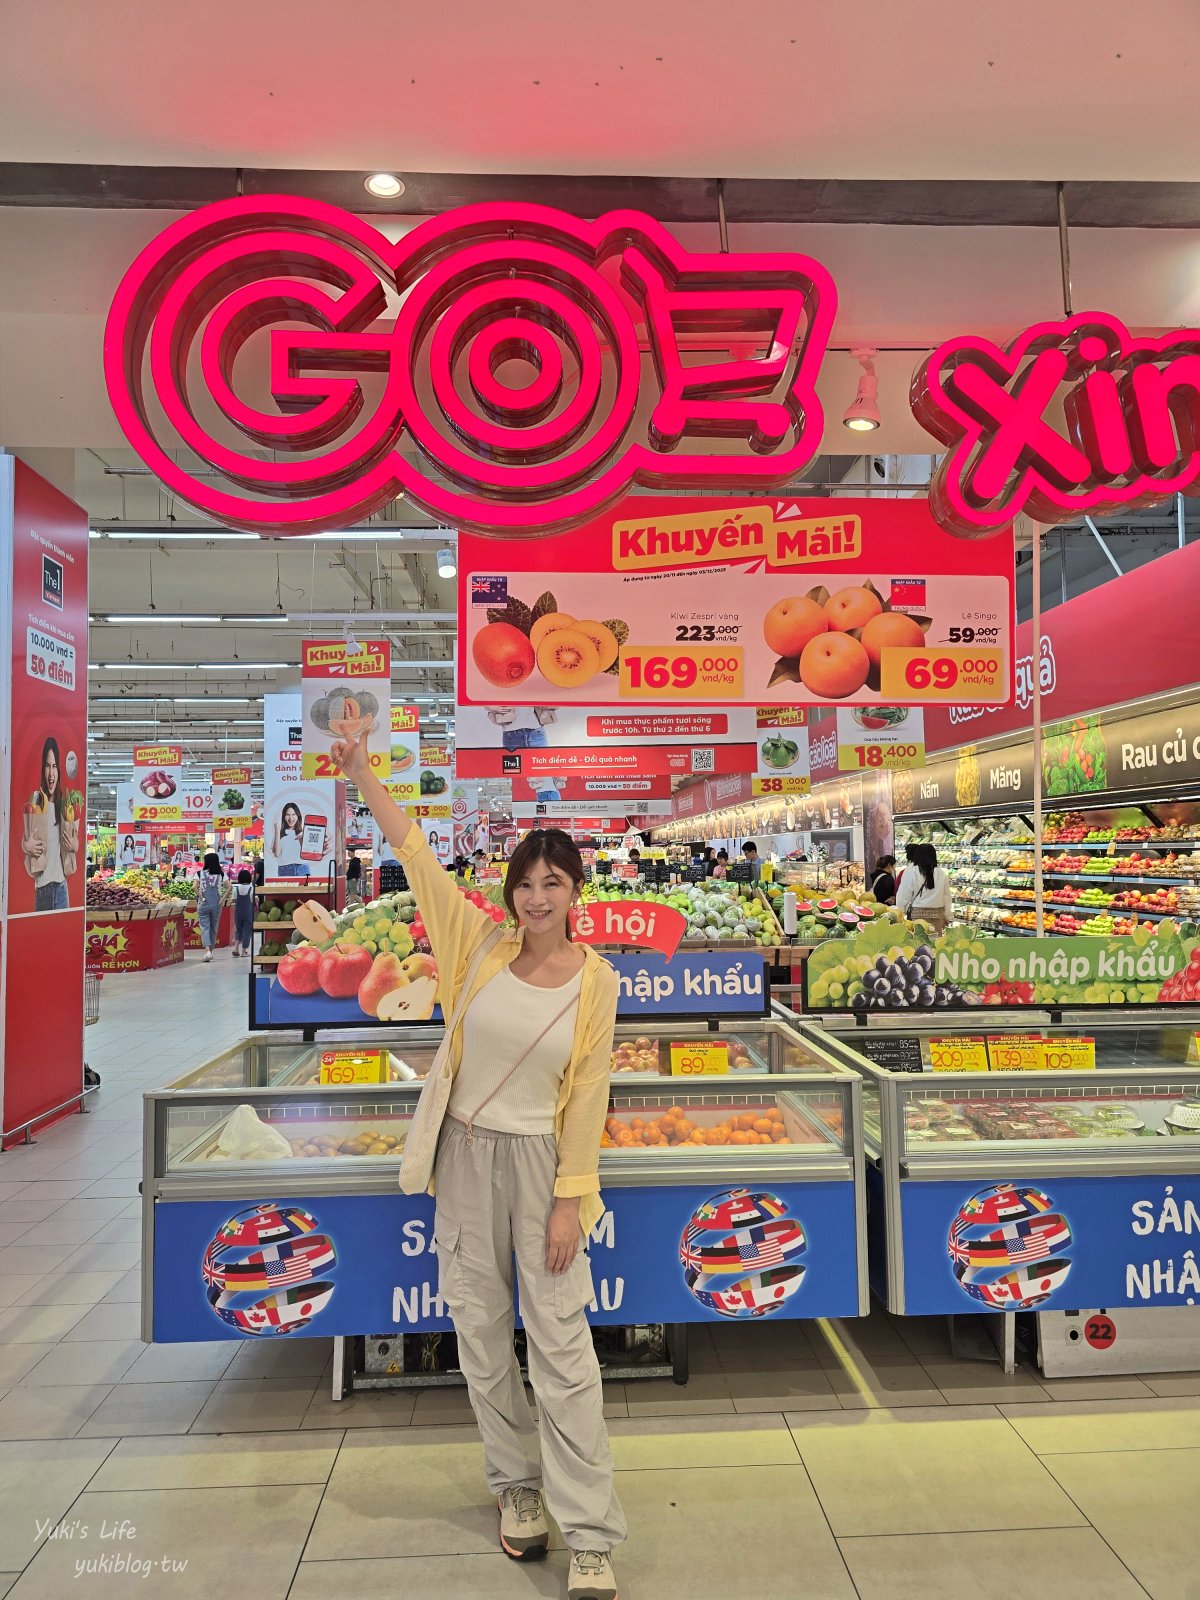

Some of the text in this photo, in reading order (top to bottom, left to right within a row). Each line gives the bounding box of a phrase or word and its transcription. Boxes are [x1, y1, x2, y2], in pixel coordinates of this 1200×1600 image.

[619, 513, 856, 560] Khuyến Mãi!
[670, 612, 739, 622] Kiwi Zespri vàng
[974, 612, 998, 621] Singo
[31, 632, 55, 652] 10.000
[56, 646, 68, 658] vnd
[715, 635, 738, 643] vnd/kg
[974, 636, 997, 644] vnd/kg
[31, 654, 73, 686] 50 điểm
[350, 655, 382, 673] Mãi!
[701, 673, 735, 684] vnd/kg
[962, 673, 995, 685] vnd/kg
[602, 726, 623, 734] trước
[674, 725, 689, 733] đến
[634, 718, 650, 726] thực
[652, 716, 674, 726] phẩm
[675, 716, 691, 724] tươi
[693, 716, 712, 725] sống
[1121, 743, 1158, 771] Rau
[1162, 727, 1187, 764] củ
[531, 756, 547, 764] Tích
[548, 755, 567, 764] điểm
[584, 754, 597, 763] Đổi
[598, 756, 613, 764] quà
[614, 755, 637, 763] nhanh
[990, 765, 1021, 791] Măng
[920, 777, 940, 800] Nấm
[605, 907, 656, 941] hội
[101, 958, 117, 969] RẺ
[117, 960, 140, 968] HƠN
[937, 940, 1176, 985] Nho nhập khẩu
[684, 962, 762, 996] khẩu
[1089, 1323, 1112, 1340] 22
